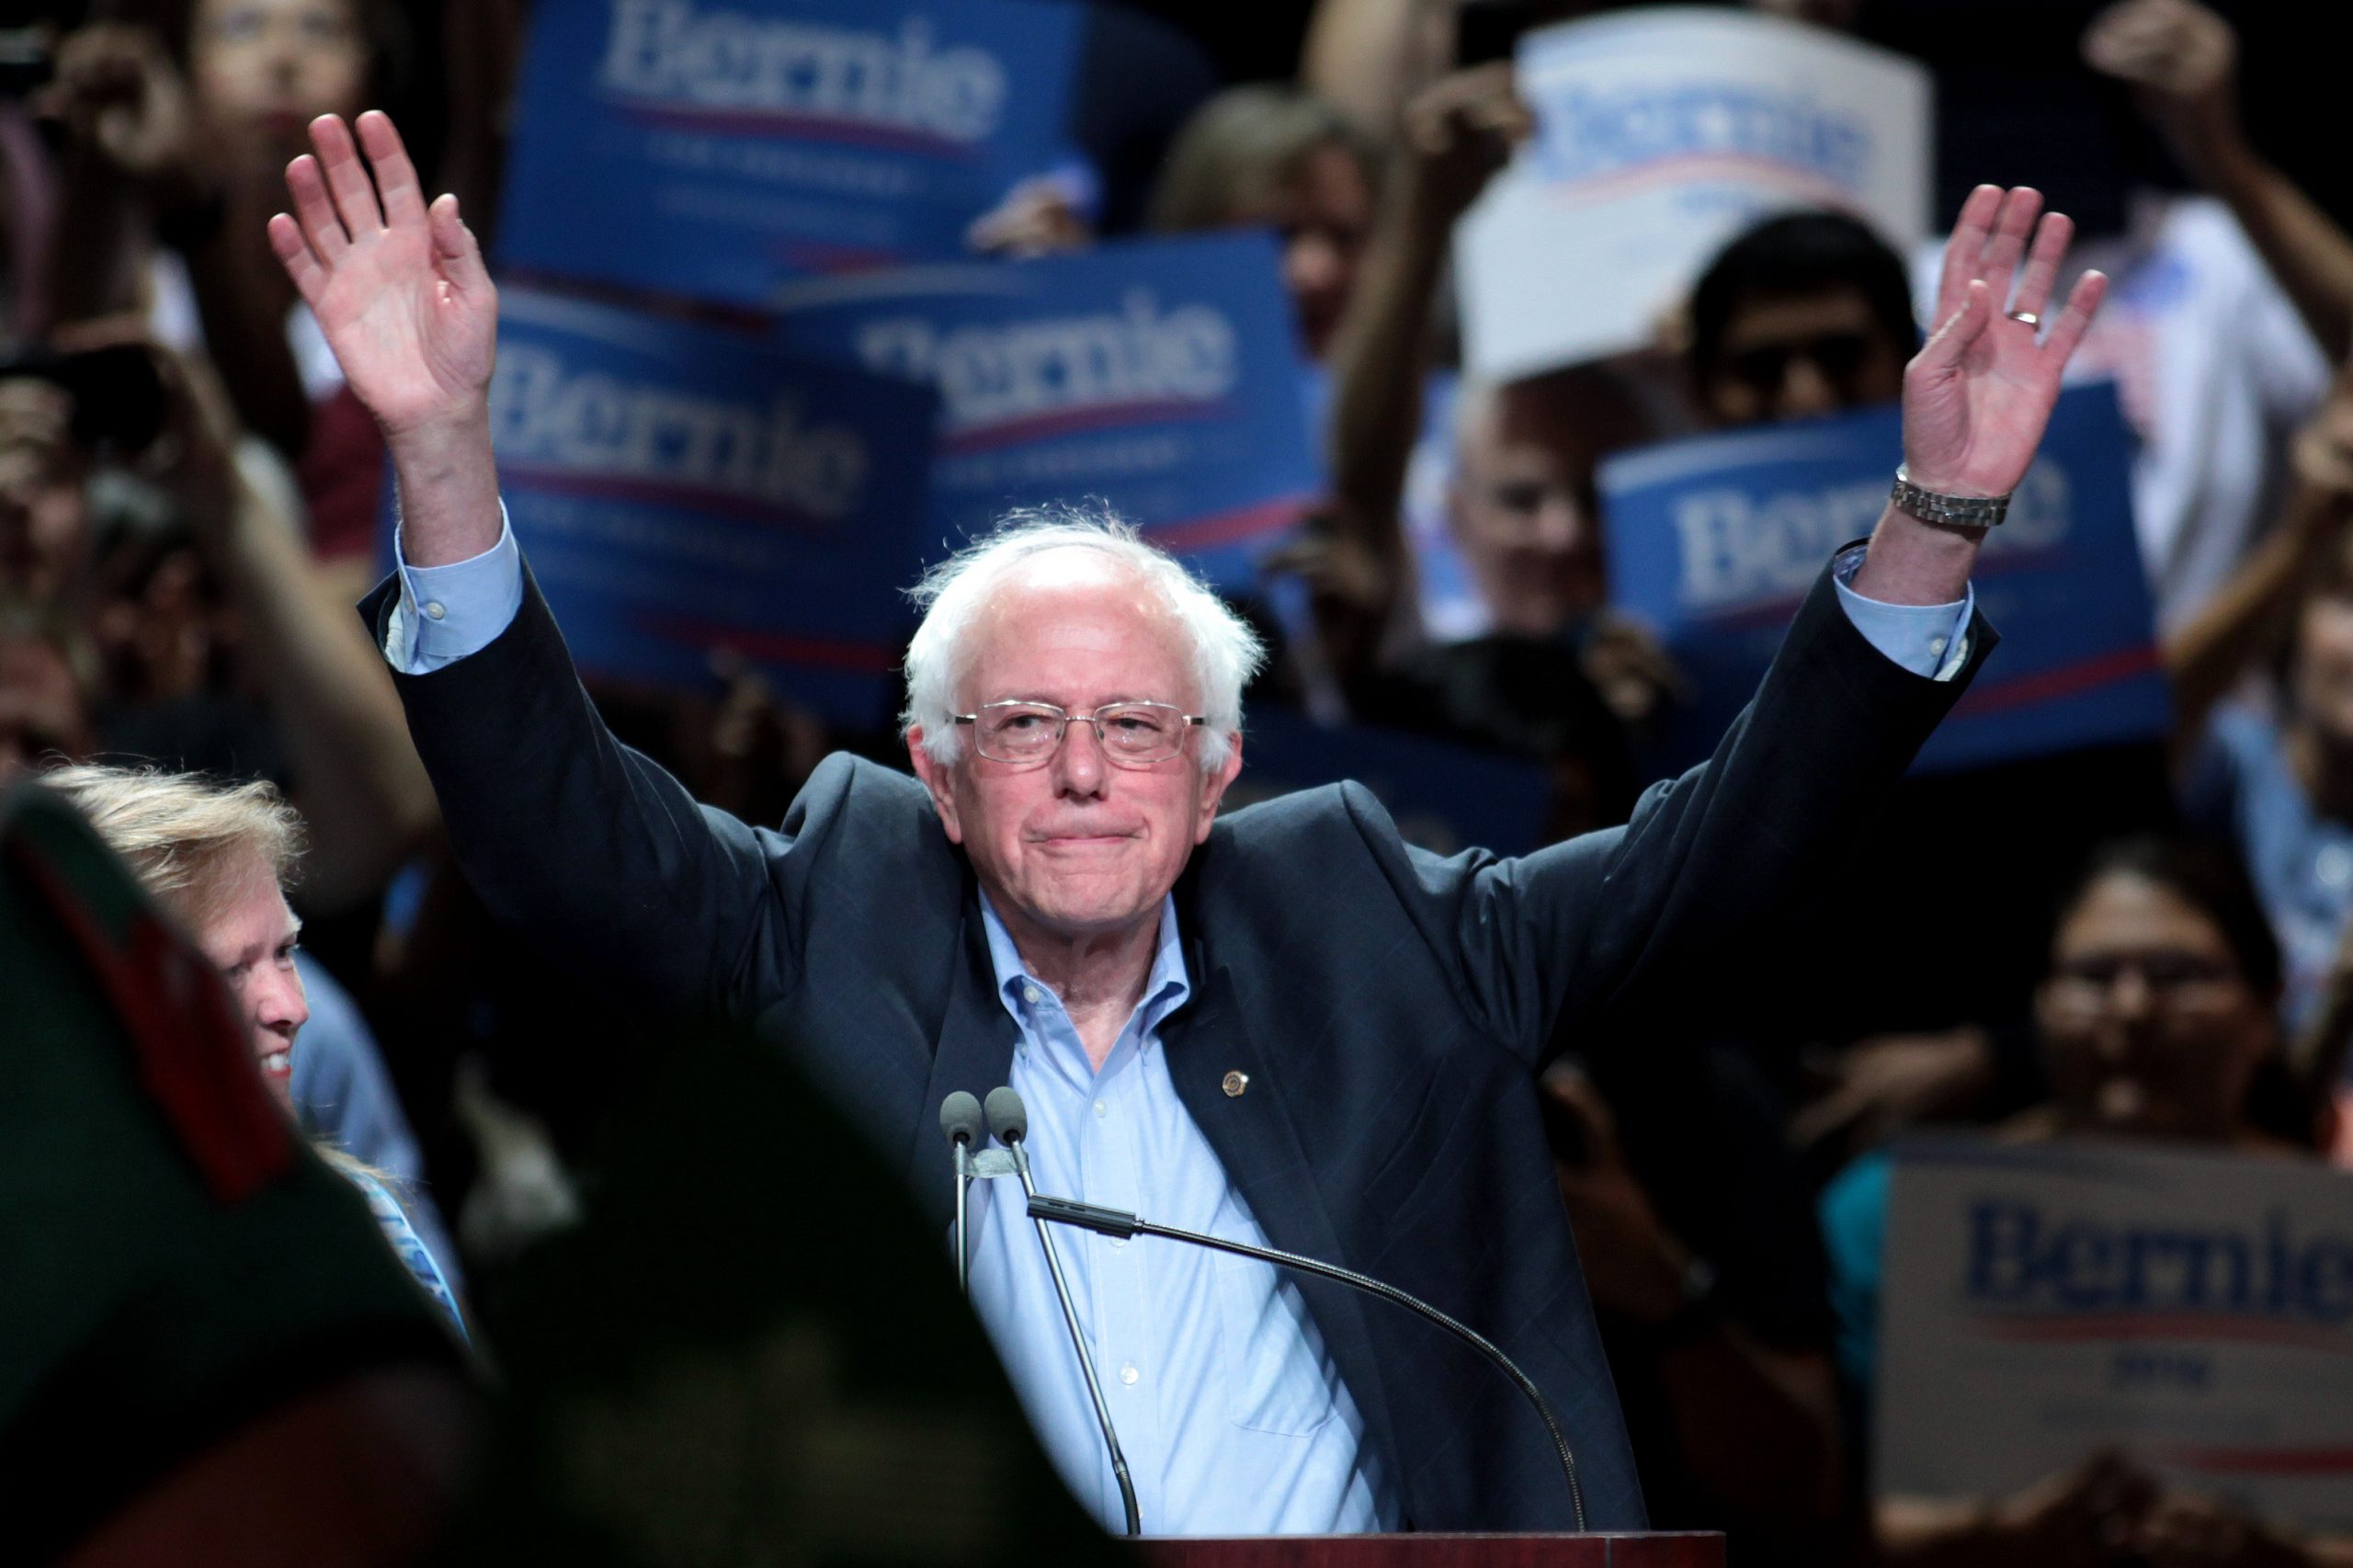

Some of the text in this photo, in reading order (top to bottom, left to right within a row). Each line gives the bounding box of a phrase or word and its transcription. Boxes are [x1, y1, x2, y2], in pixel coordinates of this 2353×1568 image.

[601, 0, 1006, 140] Bernie
[1673, 460, 2074, 603] Bere
[1967, 1200, 2353, 1327] Bernie
